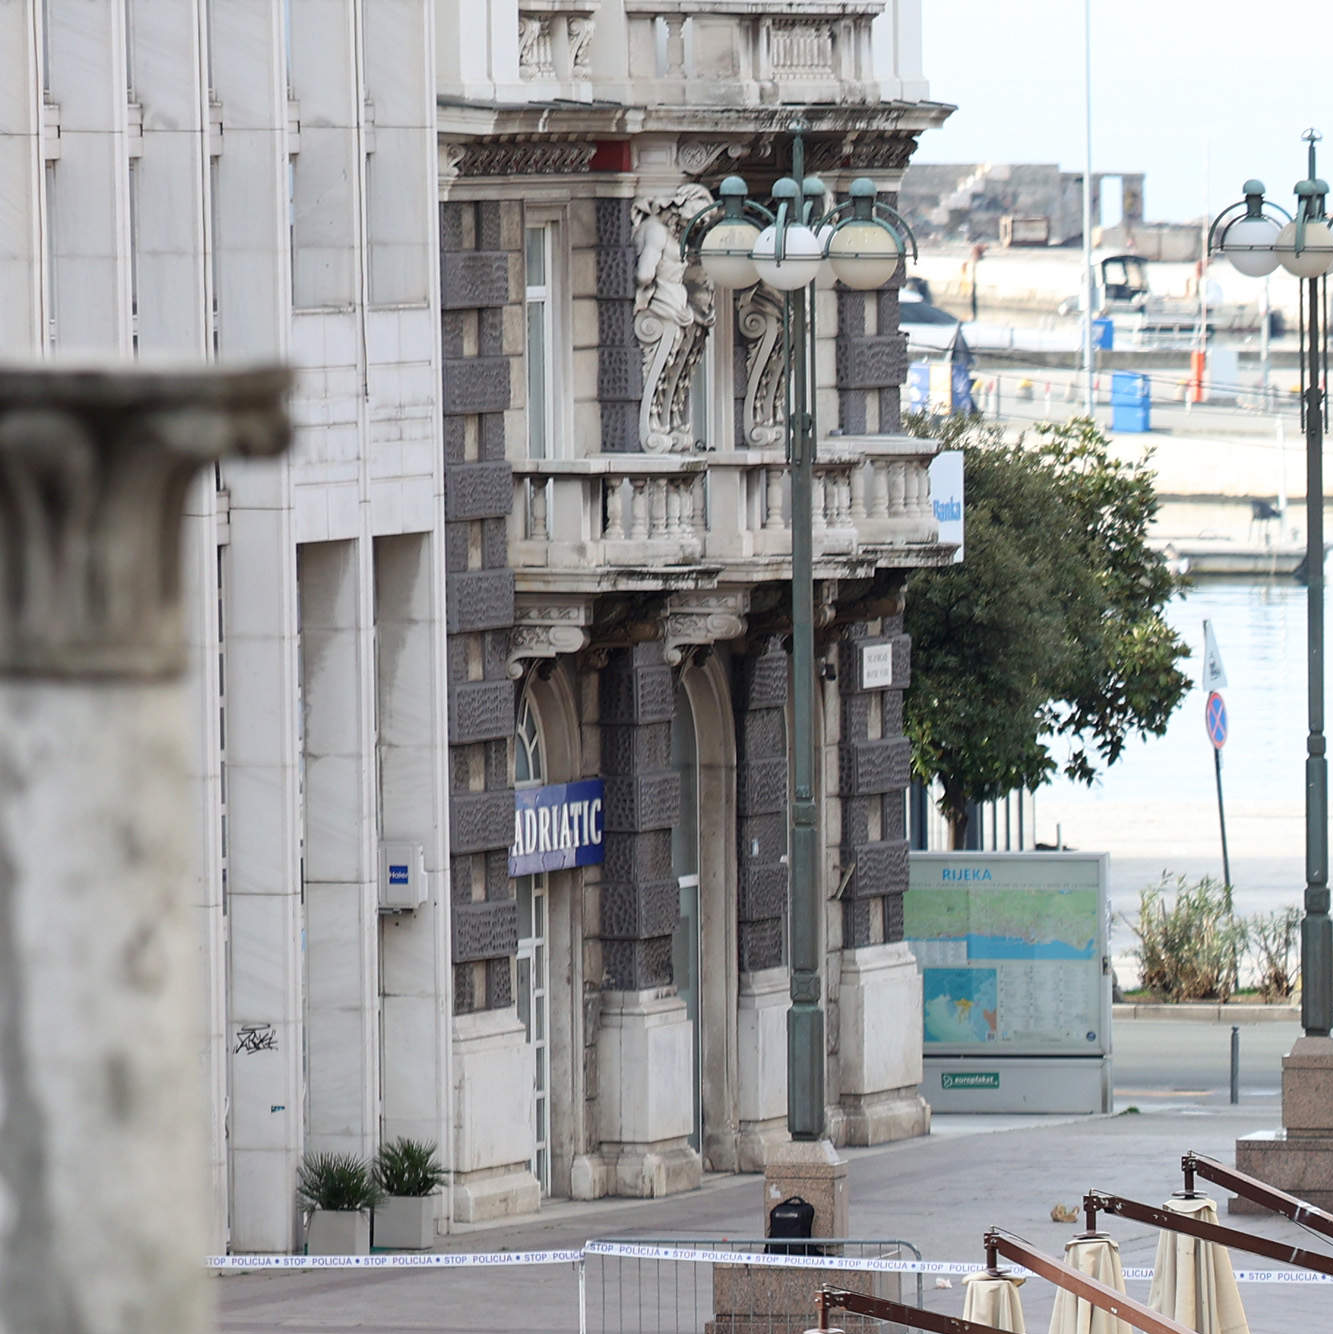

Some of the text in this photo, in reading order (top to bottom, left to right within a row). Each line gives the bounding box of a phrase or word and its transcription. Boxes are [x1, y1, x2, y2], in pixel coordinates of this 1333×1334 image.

[511, 798, 602, 857] ADRIATIC
[942, 869, 992, 881] RIJEKA
[231, 1258, 271, 1266] POLICIJA
[283, 1258, 307, 1266] STOP
[312, 1257, 352, 1266] POLICIJA
[364, 1257, 387, 1266] STOP
[392, 1256, 432, 1265] POLICIJA
[444, 1256, 467, 1264] STOP
[473, 1254, 513, 1263] POLICIJA
[524, 1253, 547, 1262] STOP
[590, 1243, 614, 1253] STOP
[620, 1246, 660, 1257] POLICIJA
[673, 1250, 696, 1259] STOP
[702, 1252, 743, 1262] POLICIJA
[755, 1255, 779, 1264] STOP
[784, 1257, 826, 1266] POLICIJA
[838, 1259, 861, 1268] STOP
[867, 1261, 908, 1270] POLICIJA
[920, 1263, 944, 1271] STOP
[1249, 1272, 1272, 1280] STOP
[1278, 1273, 1318, 1281] POLICIJA
